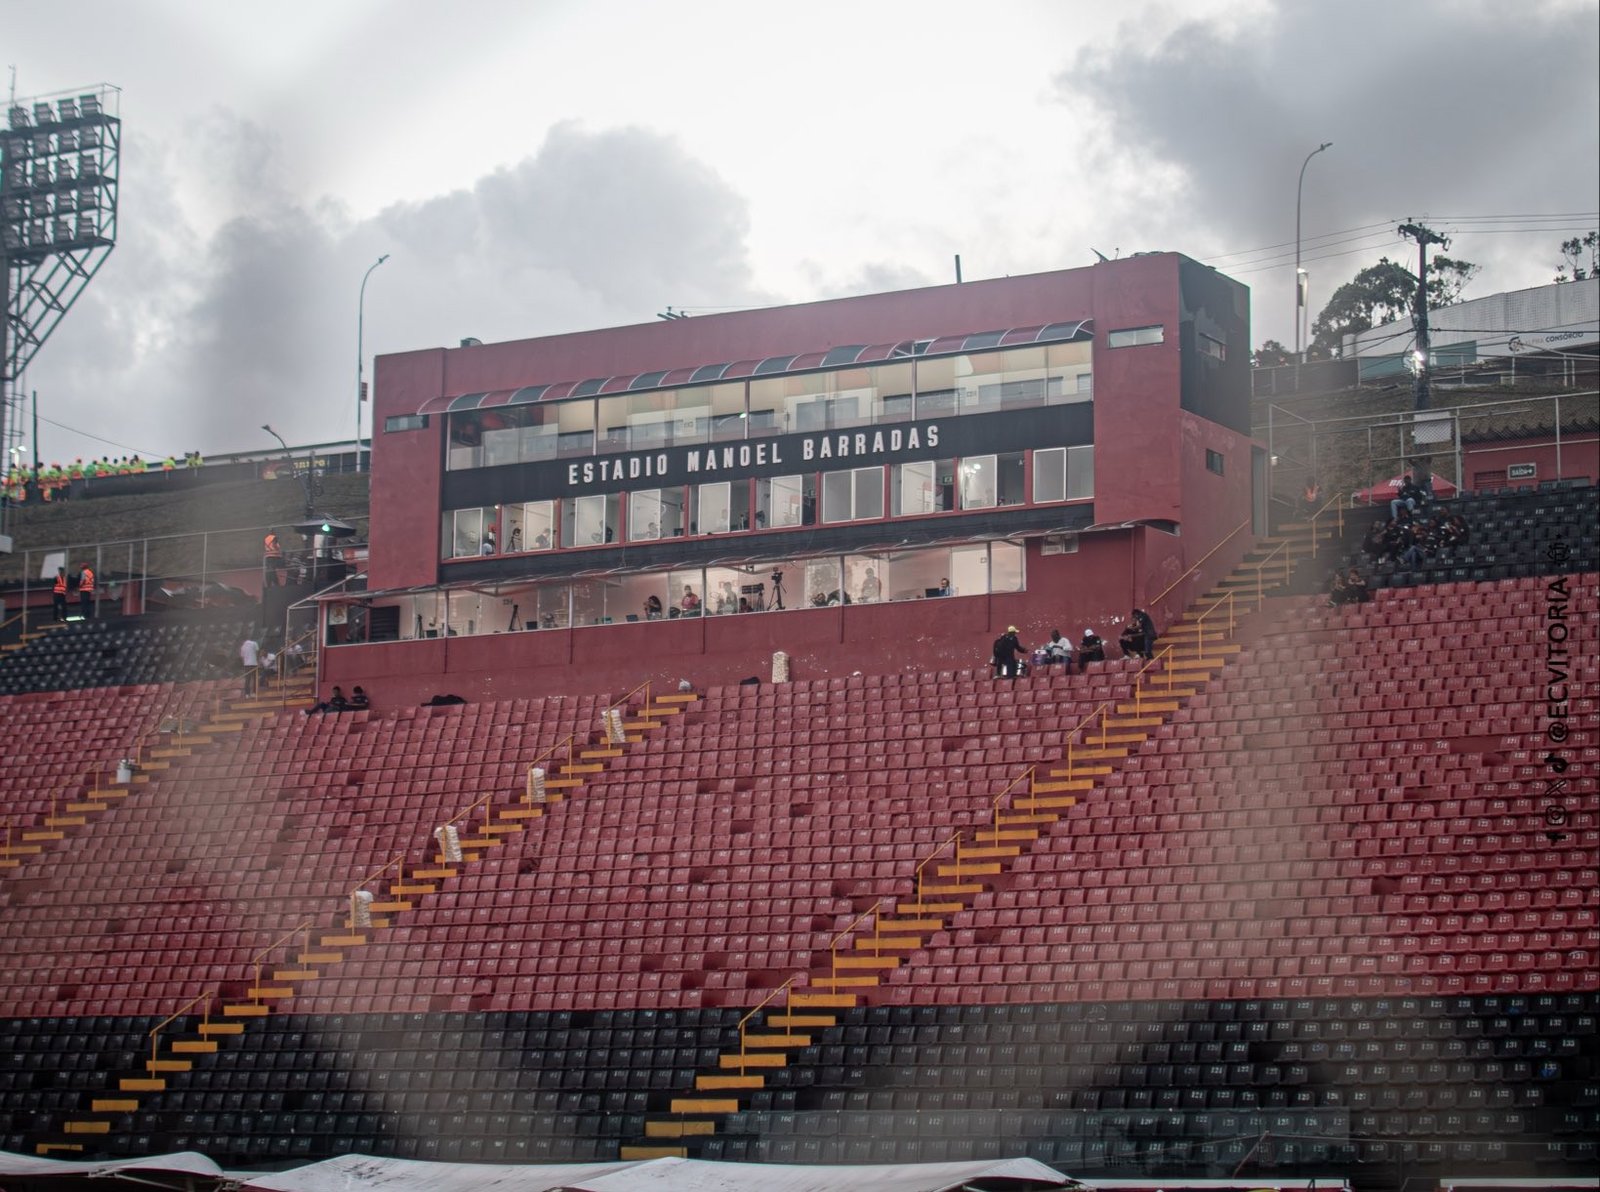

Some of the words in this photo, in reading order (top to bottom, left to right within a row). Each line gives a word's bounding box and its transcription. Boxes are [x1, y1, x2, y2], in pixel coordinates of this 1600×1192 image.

[568, 454, 668, 485] ESTADIO
[687, 442, 783, 473] MANOEL
[803, 425, 941, 461] BARRADAS
